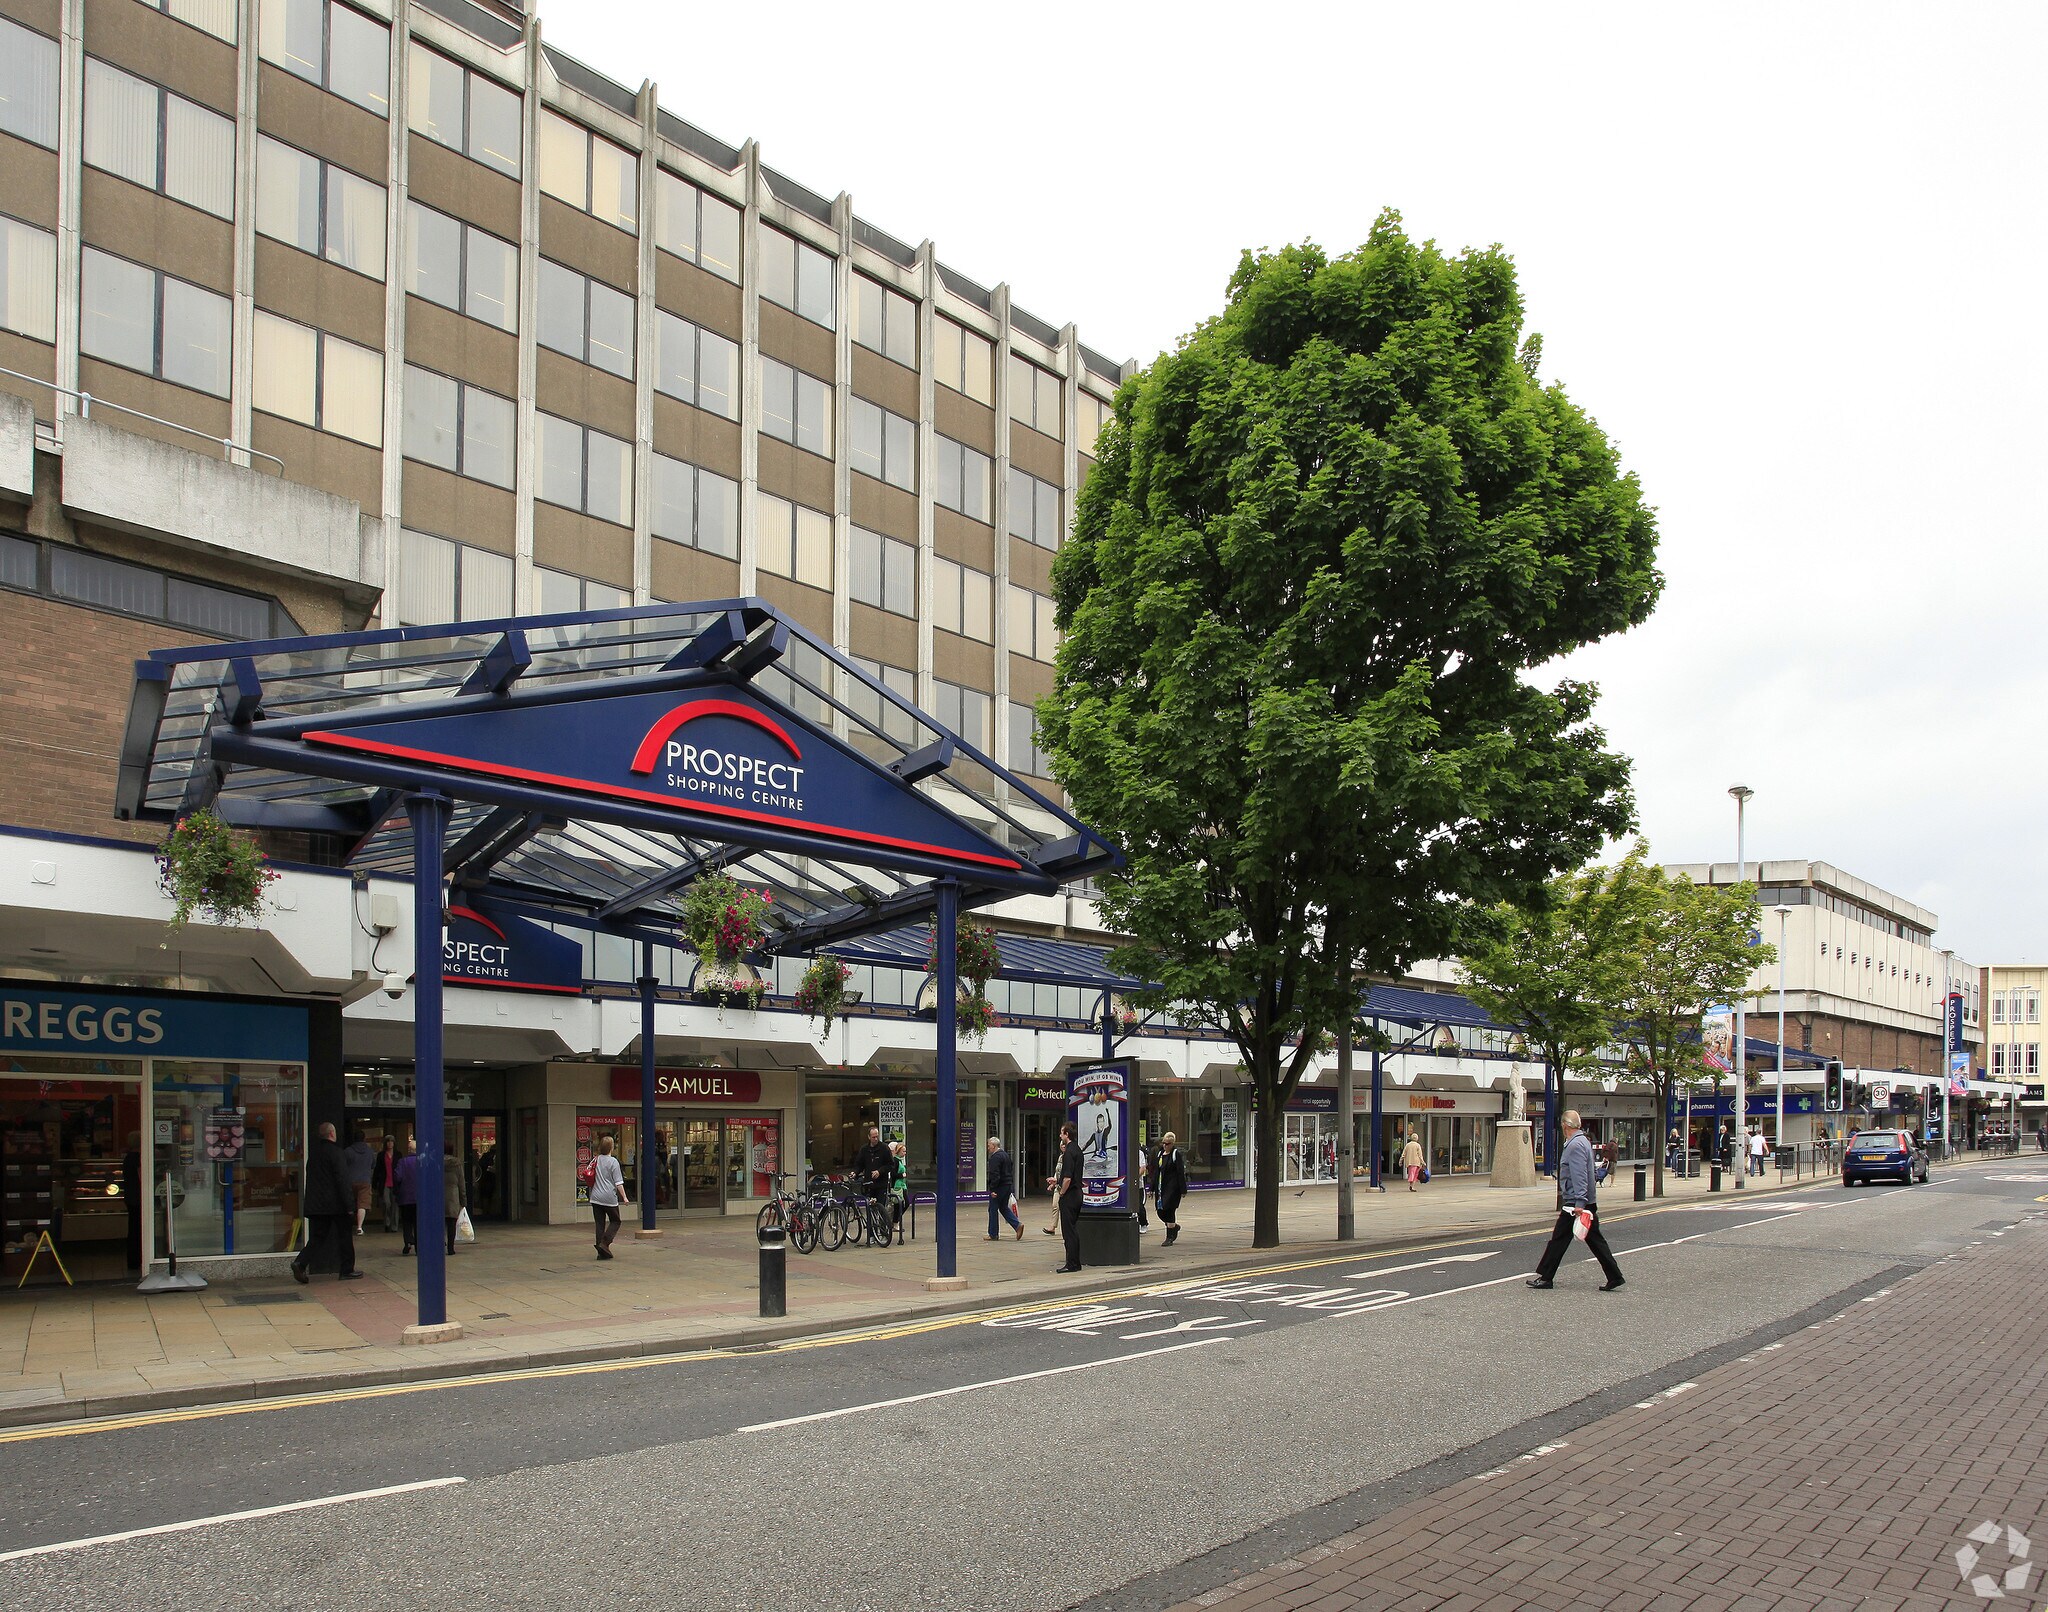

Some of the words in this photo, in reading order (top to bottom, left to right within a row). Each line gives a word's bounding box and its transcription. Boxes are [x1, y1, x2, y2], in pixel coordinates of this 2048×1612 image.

[667, 740, 804, 792] PROSPECT
[667, 774, 745, 800] SHOPPING
[752, 790, 804, 811] CENTRE
[466, 965, 509, 977] CENTRE
[1409, 1094, 1455, 1111] BrightHouse
[1119, 1280, 1410, 1310] AHEAD
[981, 1304, 1266, 1340] ONLY
